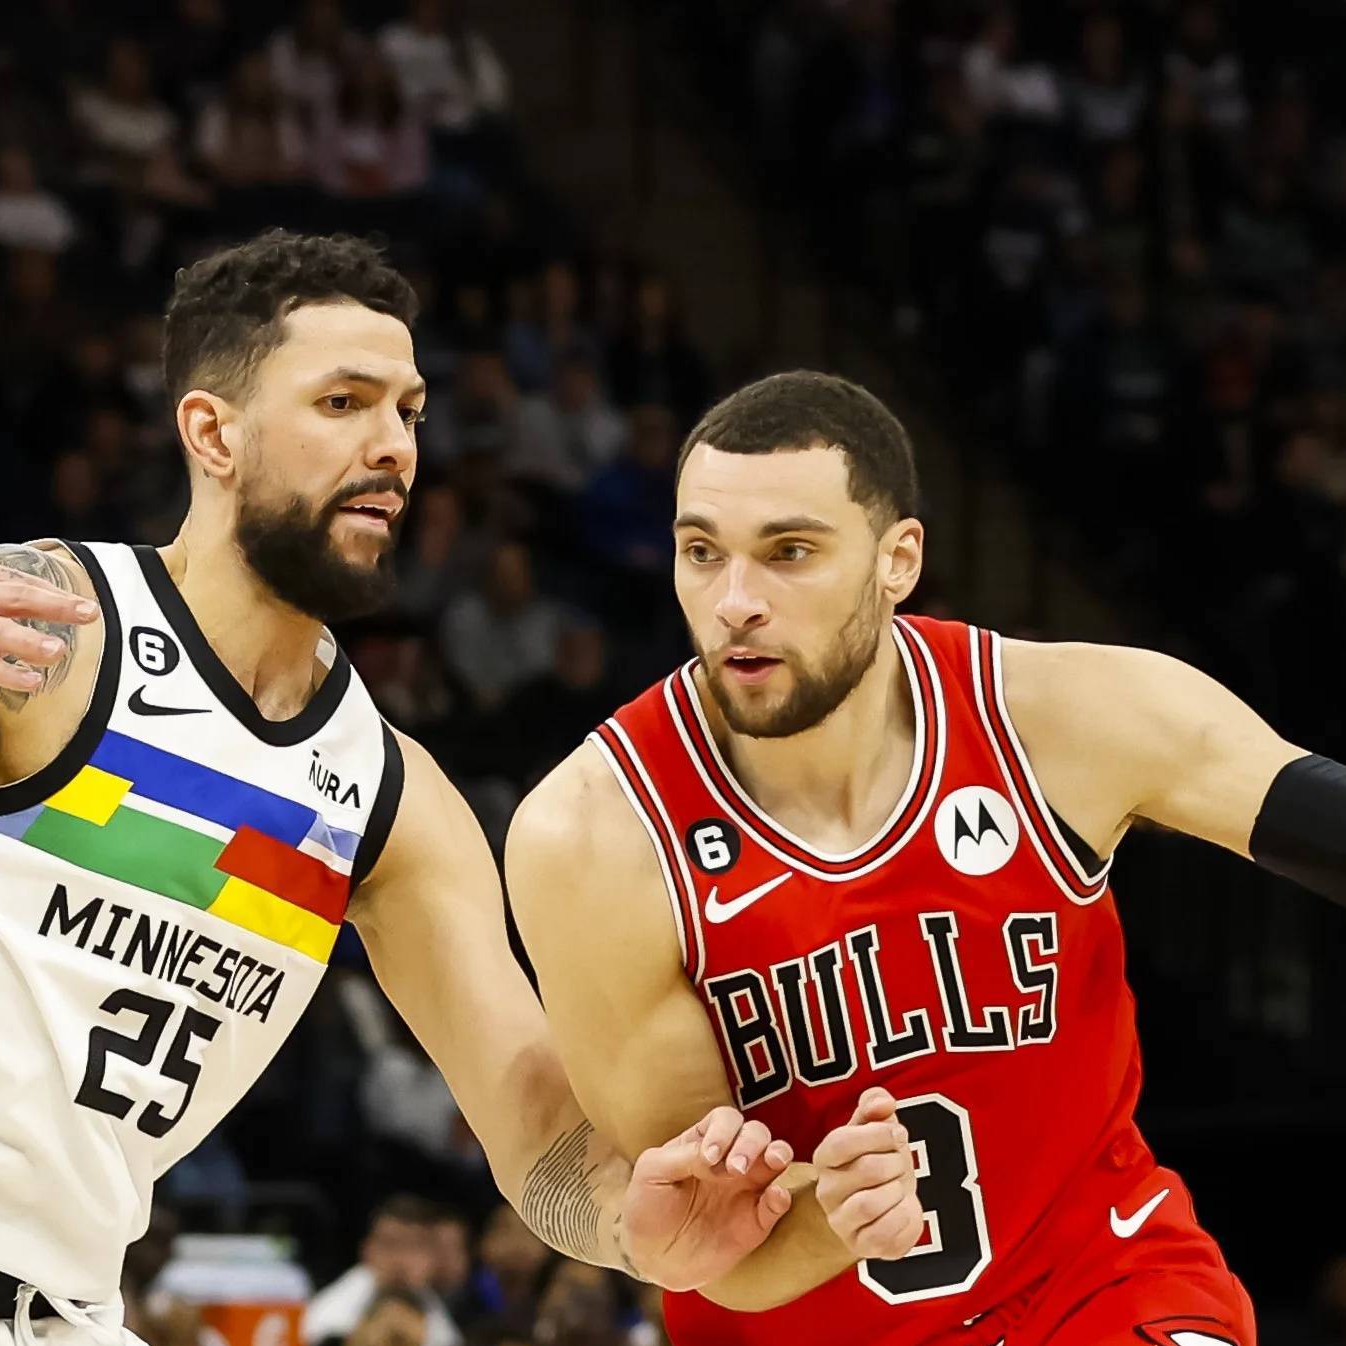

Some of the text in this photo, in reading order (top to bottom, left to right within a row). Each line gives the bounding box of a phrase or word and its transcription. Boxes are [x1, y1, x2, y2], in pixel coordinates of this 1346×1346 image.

[137, 632, 166, 671] 6
[694, 825, 731, 870] 6
[38, 883, 286, 1025] MINNESOTA
[704, 911, 1059, 1112] BULLS
[74, 987, 223, 1139] 25
[857, 1093, 993, 1306] 3
